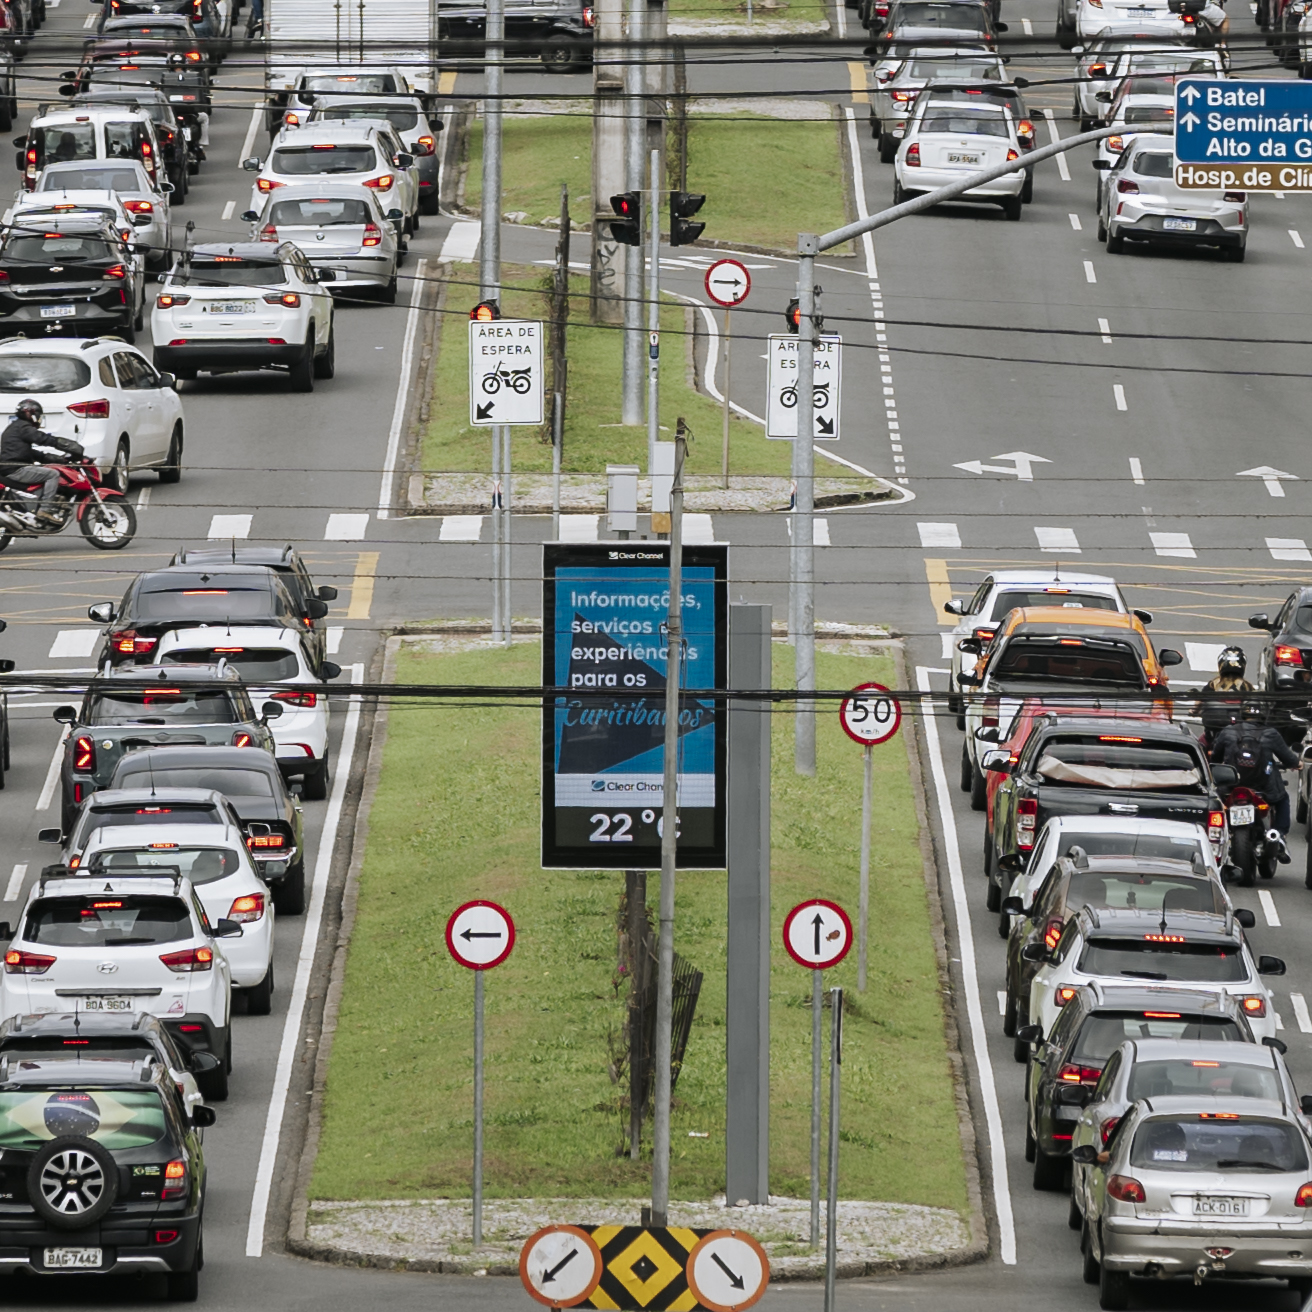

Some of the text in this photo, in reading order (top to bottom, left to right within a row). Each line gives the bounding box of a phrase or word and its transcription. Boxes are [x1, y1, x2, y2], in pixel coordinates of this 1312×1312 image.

[1207, 87, 1265, 106] Batel
[1206, 137, 1251, 157] Alto
[1258, 138, 1287, 157] da
[478, 325, 535, 338] ÁREA DE
[481, 345, 532, 356] ESPERA
[637, 551, 664, 559] Channel
[571, 619, 653, 638] serviços
[571, 647, 698, 664] experiêncas
[571, 672, 647, 689] para os
[564, 698, 704, 728] Curitibaos
[852, 697, 891, 723] 50
[607, 781, 635, 792] Clear
[589, 813, 634, 842] 22
